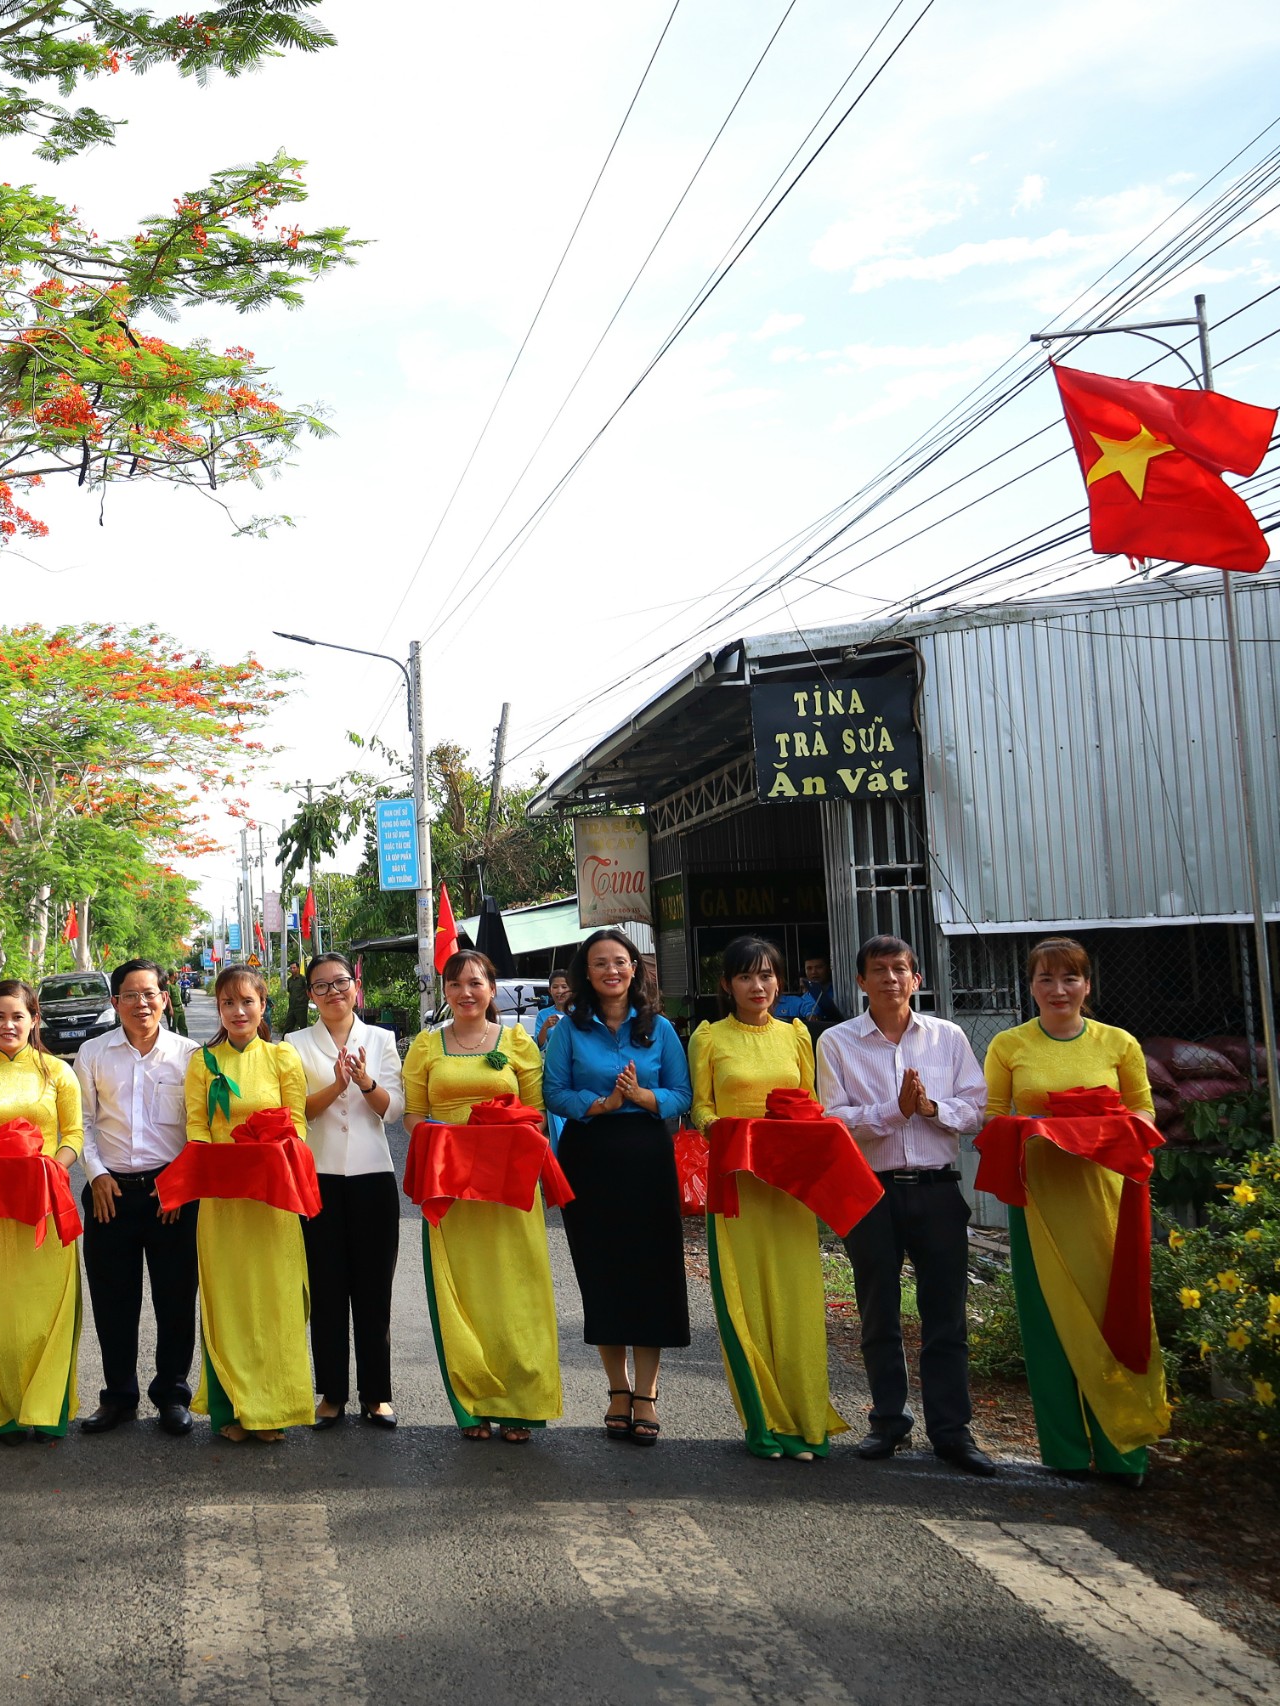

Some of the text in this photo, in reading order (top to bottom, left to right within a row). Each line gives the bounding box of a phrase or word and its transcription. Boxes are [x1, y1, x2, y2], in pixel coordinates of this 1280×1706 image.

[775, 716, 895, 758] TRÀ SỮA
[767, 760, 909, 798] Ăn Vặt
[582, 855, 646, 900] Tina
